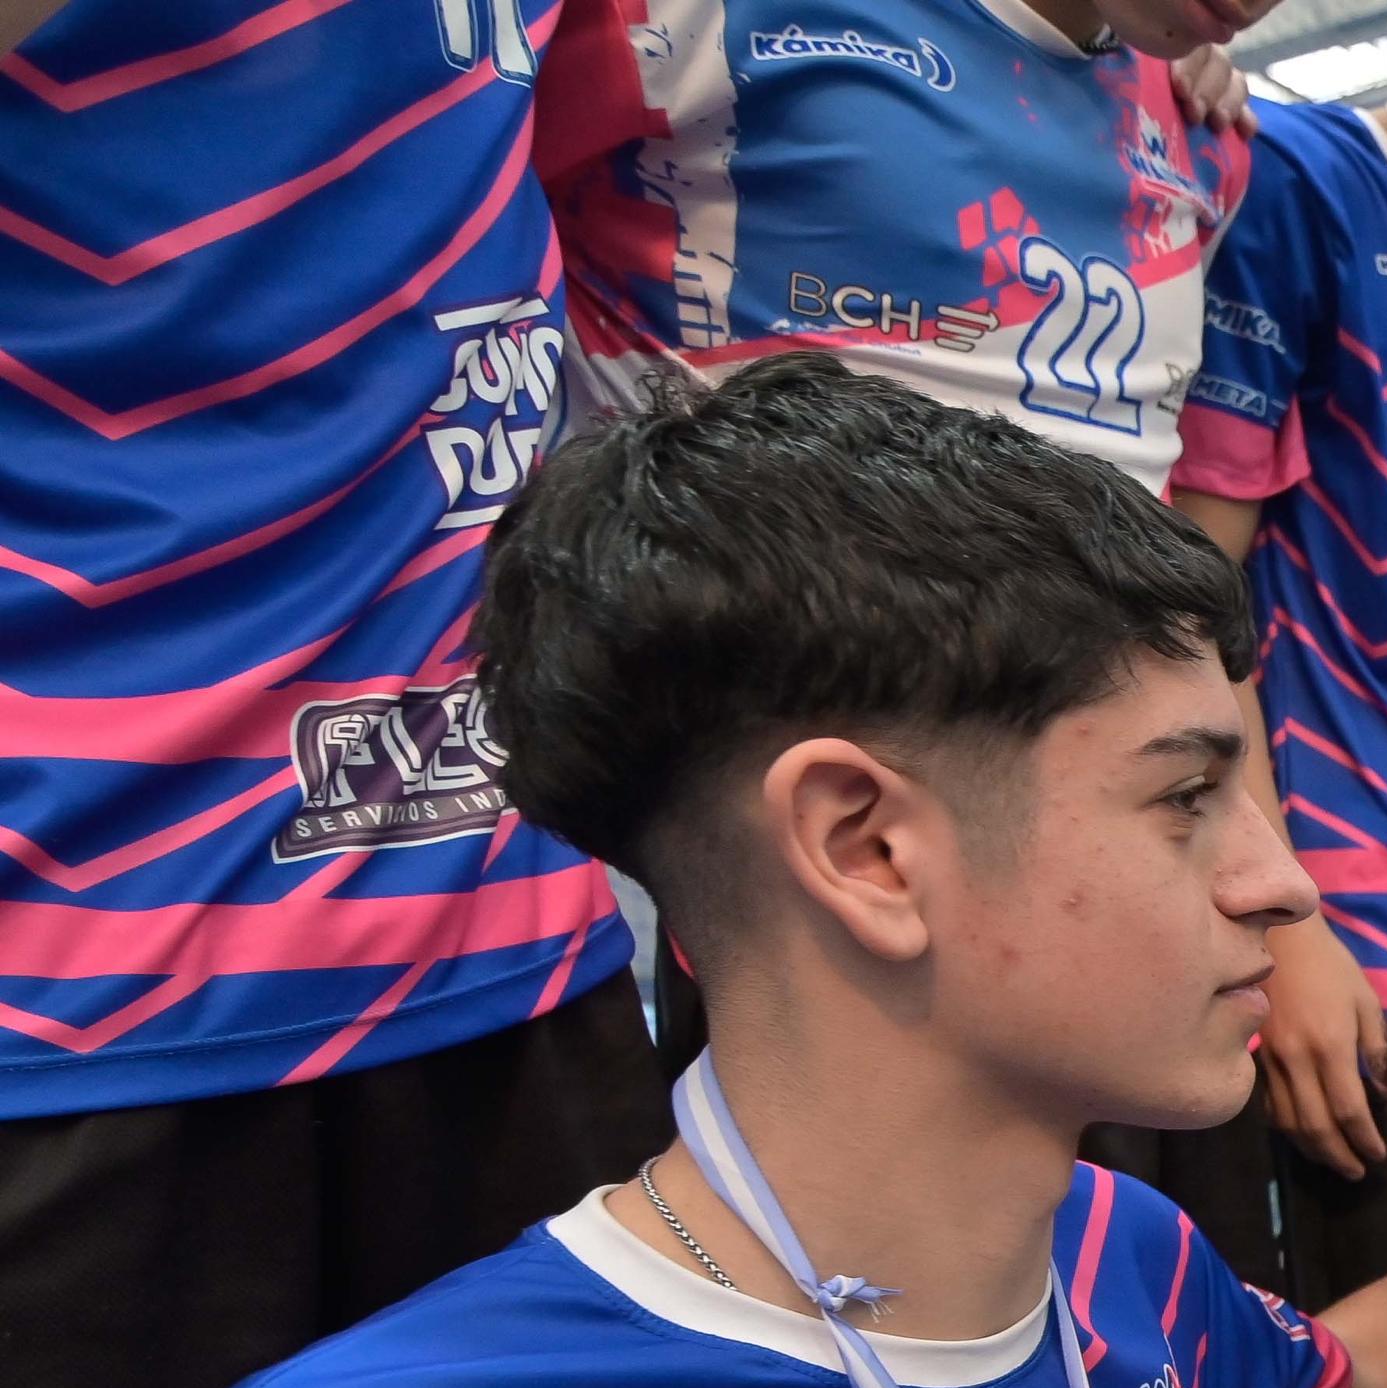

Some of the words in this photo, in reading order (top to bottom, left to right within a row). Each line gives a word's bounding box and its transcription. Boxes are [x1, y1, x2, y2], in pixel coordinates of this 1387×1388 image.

[750, 25, 922, 77] kámika
[788, 270, 922, 343] BCH
[1018, 236, 1142, 437] 22
